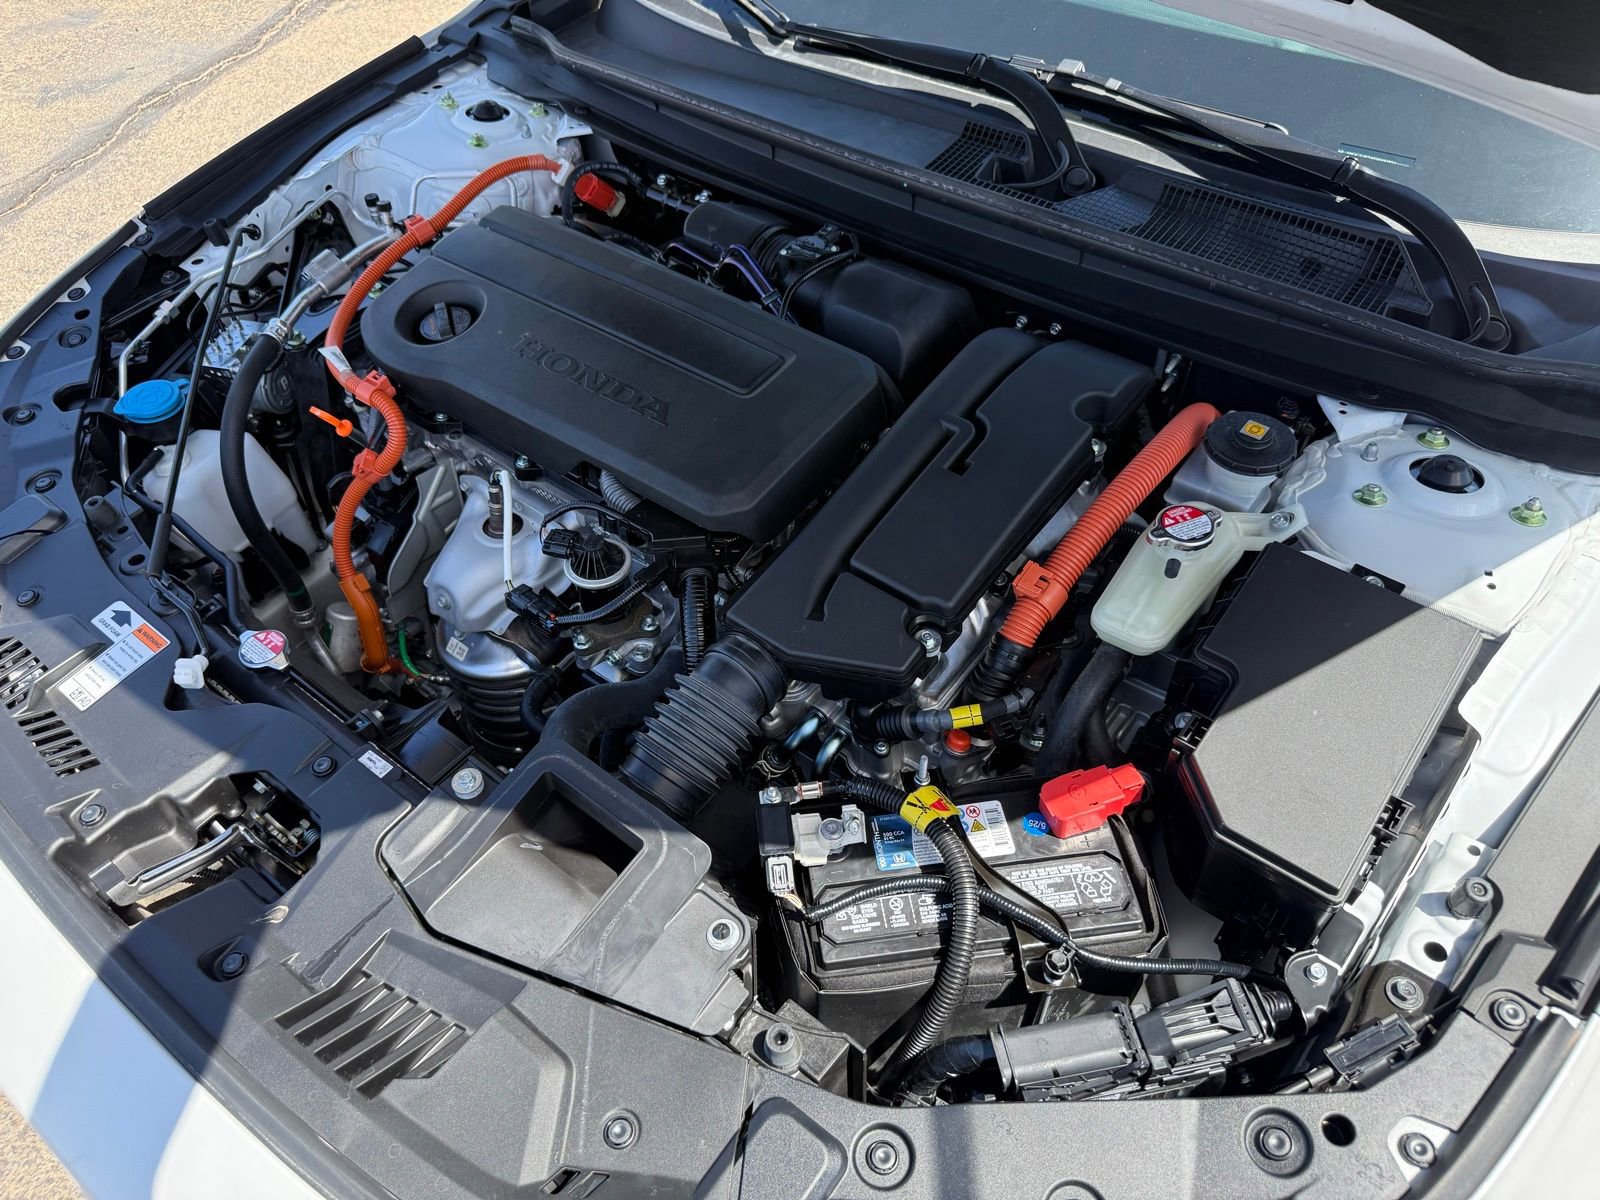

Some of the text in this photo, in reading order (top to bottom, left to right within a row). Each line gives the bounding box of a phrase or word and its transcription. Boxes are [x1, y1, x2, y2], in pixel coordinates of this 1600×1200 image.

[508, 332, 669, 427] HONDA
[98, 617, 122, 638] GRAB FOAM
[141, 628, 162, 649] WARNING
[1028, 819, 1047, 830] 5/25
[874, 831, 884, 857] MONTH
